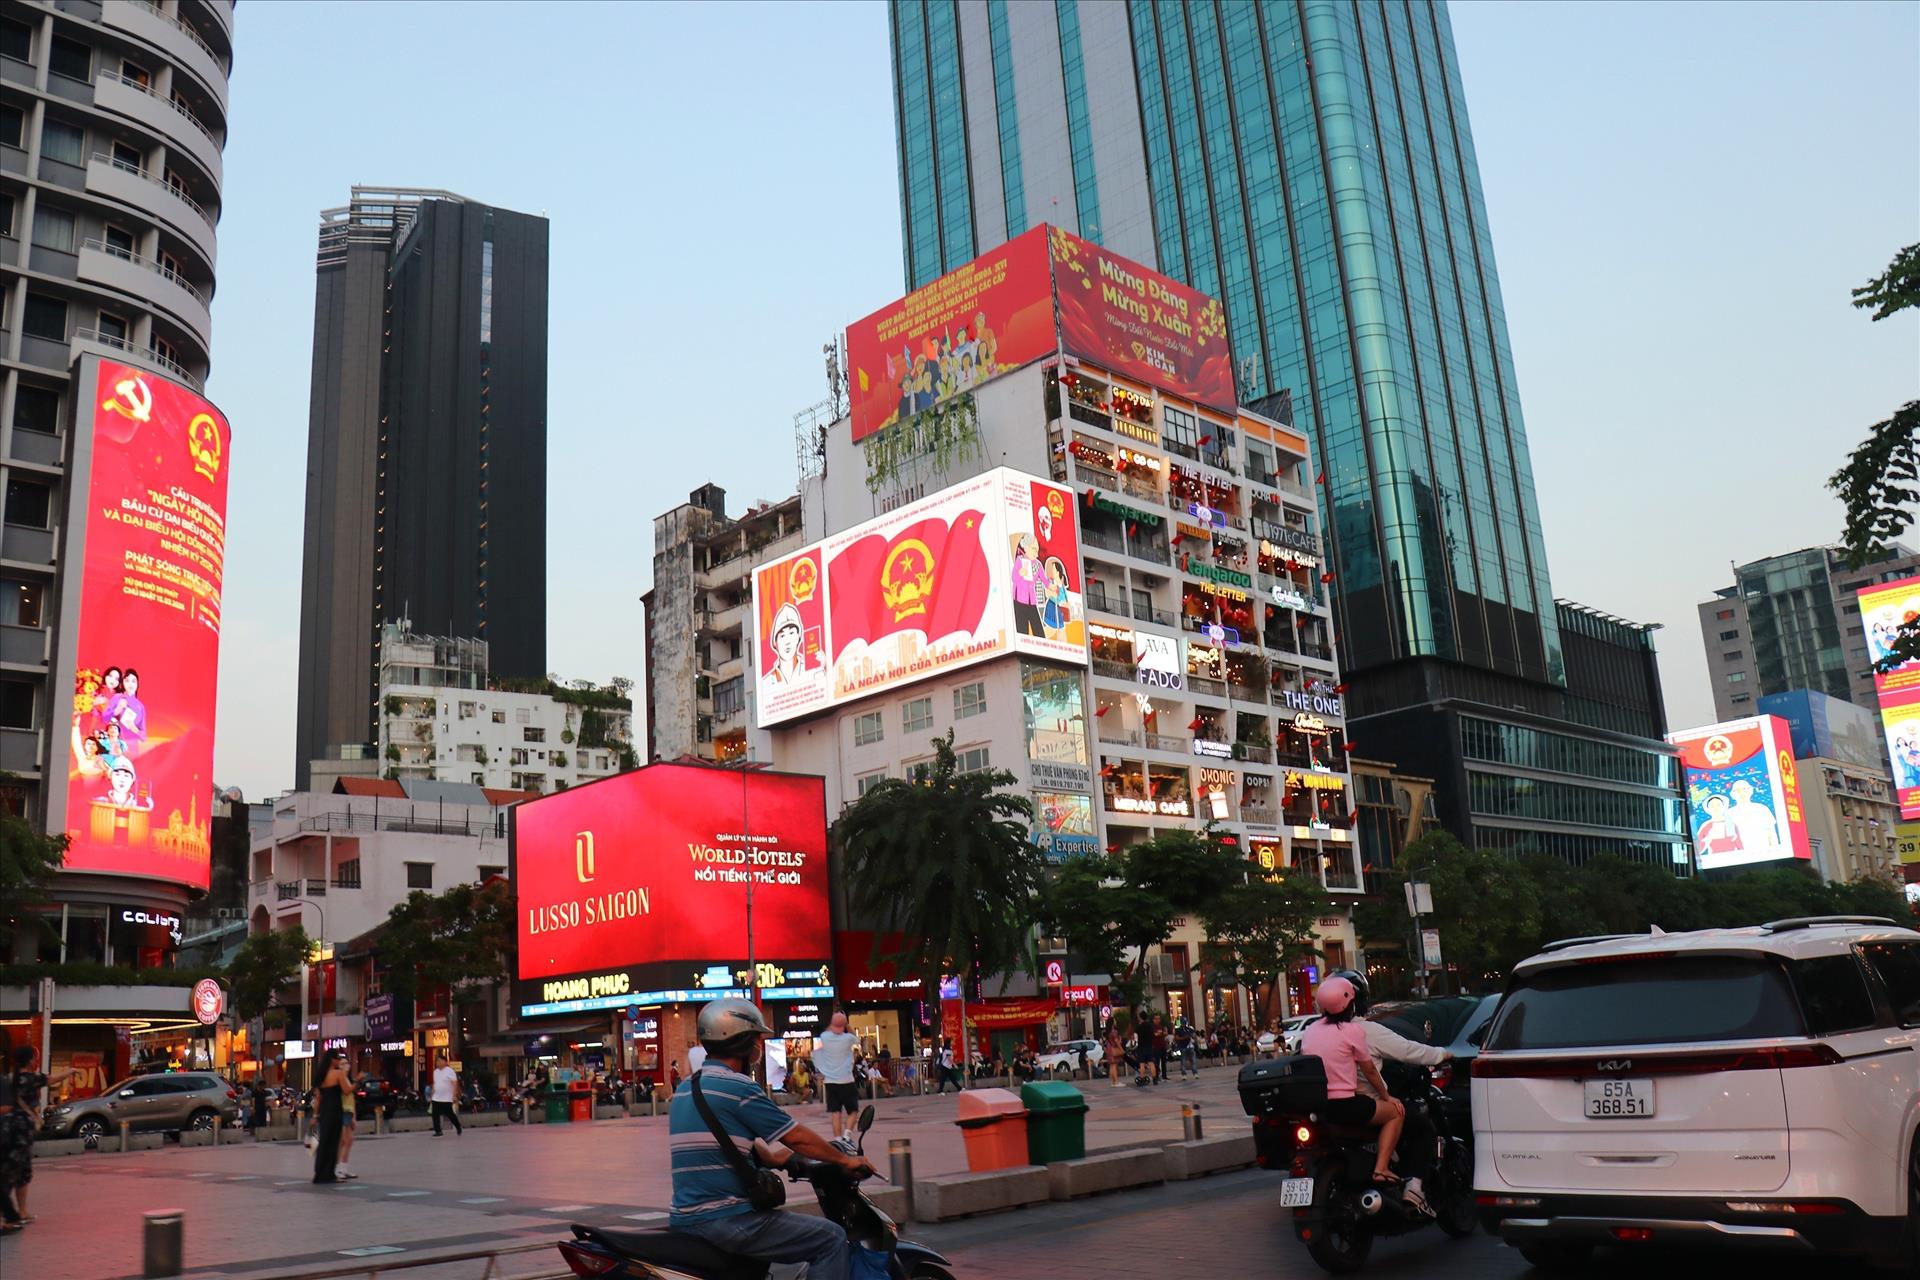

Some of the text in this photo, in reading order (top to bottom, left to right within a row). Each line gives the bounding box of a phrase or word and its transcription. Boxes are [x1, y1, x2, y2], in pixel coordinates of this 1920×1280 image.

[1098, 257, 1188, 316] Mừng Đảng
[1102, 283, 1192, 338] Mừng Xuân
[1146, 346, 1164, 360] KIM
[1181, 464, 1232, 492] THE LETTER
[102, 508, 121, 521] VÀ
[122, 513, 144, 528] ĐẠI
[1291, 531, 1318, 552] CAFE
[124, 550, 155, 566] PHÁT
[156, 559, 182, 576] SÓNG
[1180, 552, 1252, 588] Kangaroo
[1200, 581, 1246, 602] THE LETTER
[1145, 638, 1169, 656] AVA
[858, 672, 886, 688] NGÀY
[888, 664, 906, 680] HỘI
[910, 656, 932, 674] CỦA
[935, 649, 964, 665] TOÀN
[967, 638, 998, 654] DÂN!
[1140, 669, 1182, 690] FADO
[1283, 690, 1340, 716] THE ONE
[1032, 764, 1042, 776] CHO
[1303, 774, 1343, 790] DOWNTOWN
[1055, 838, 1099, 854] Expertise
[1900, 842, 1915, 853] 39
[694, 865, 716, 882] NỔI
[777, 871, 801, 885] GIỚI
[529, 886, 650, 935] LUSSO SAIGON
[755, 963, 786, 988] 50%
[543, 972, 630, 1002] HOANG PHUC
[1064, 991, 1085, 1000] CRCLE
[380, 1044, 388, 1052] THE
[1604, 1082, 1633, 1097] 65A
[1592, 1098, 1644, 1114] 368.51
[1283, 1192, 1310, 1205] 277.02
